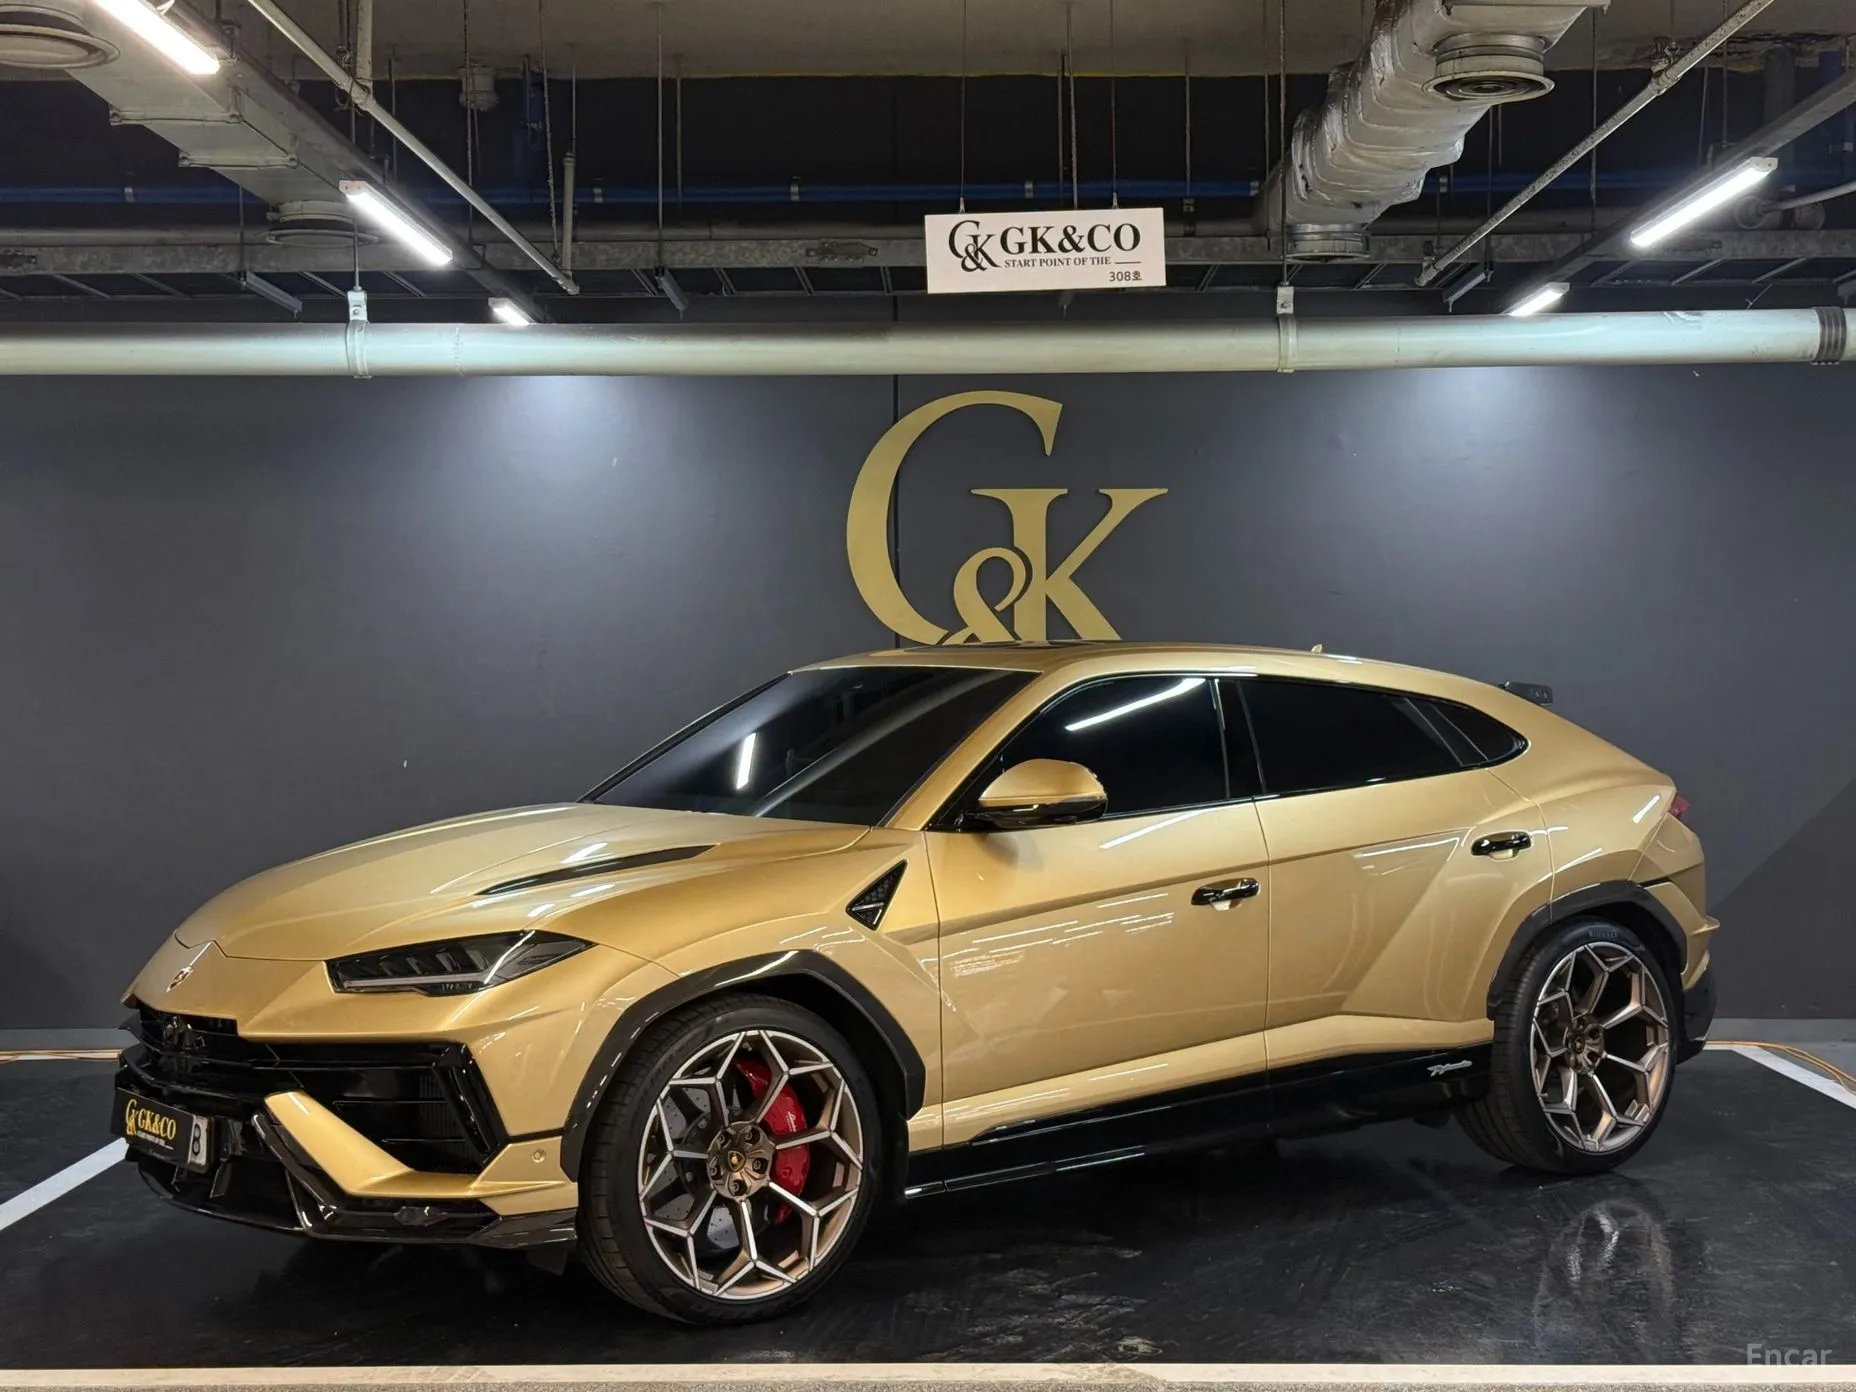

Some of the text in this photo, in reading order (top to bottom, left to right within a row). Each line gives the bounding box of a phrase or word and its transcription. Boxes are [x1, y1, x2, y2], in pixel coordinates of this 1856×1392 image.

[1000, 223, 1141, 255] GK&CO
[1004, 256, 1111, 268] START POINT OF THE
[1109, 270, 1142, 282] 308호
[137, 1108, 177, 1140] GK&CO
